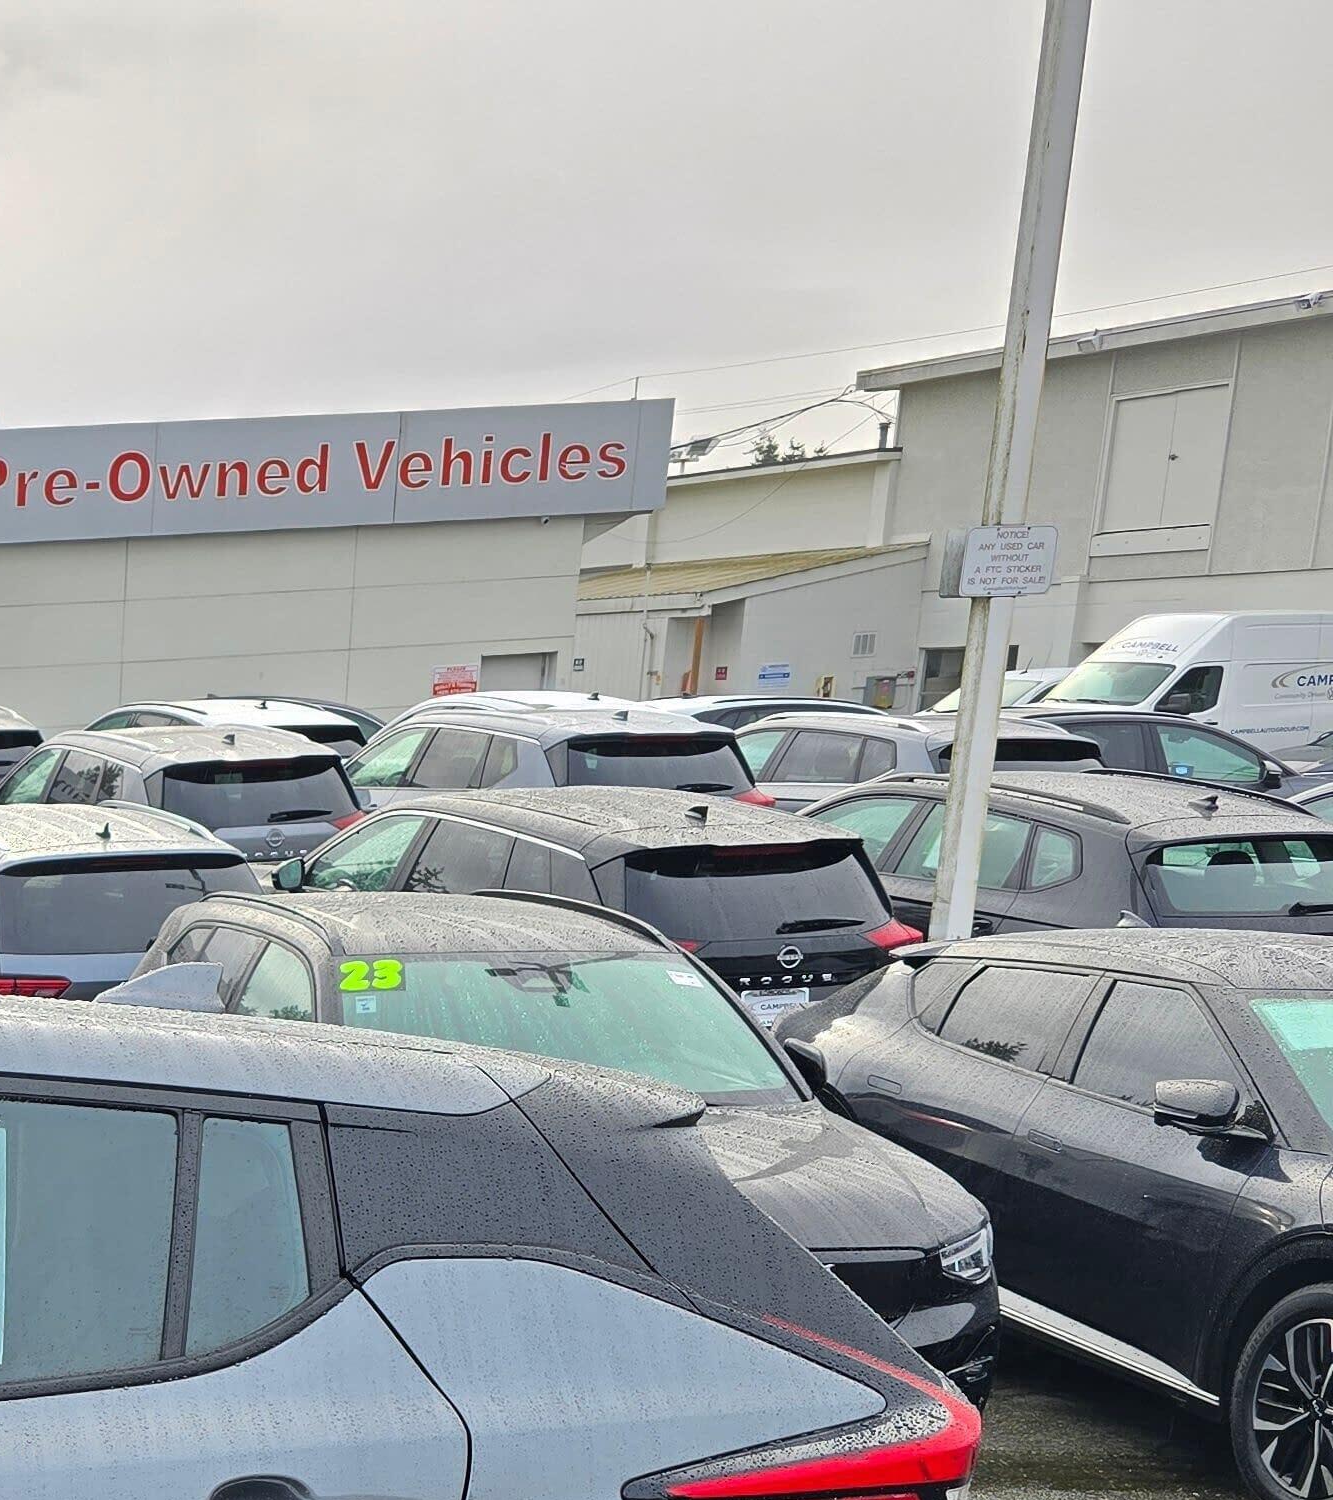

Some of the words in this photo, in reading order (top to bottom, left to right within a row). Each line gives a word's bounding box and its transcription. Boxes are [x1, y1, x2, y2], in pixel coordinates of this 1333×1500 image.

[353, 430, 629, 493] Vehicles
[996, 530, 1030, 539] NOTICE!
[978, 543, 997, 551] ANY
[1000, 542, 1023, 550] USED
[1027, 541, 1045, 550] CAR
[990, 553, 1030, 562] WITHOUT
[974, 566, 981, 574] A
[985, 565, 1002, 573] FTC
[1006, 564, 1042, 573] STICKER
[967, 577, 976, 586] IS
[979, 577, 997, 585] NOT
[1001, 576, 1019, 584] FOR
[1022, 575, 1046, 584] SALE!
[339, 959, 404, 992] 23
